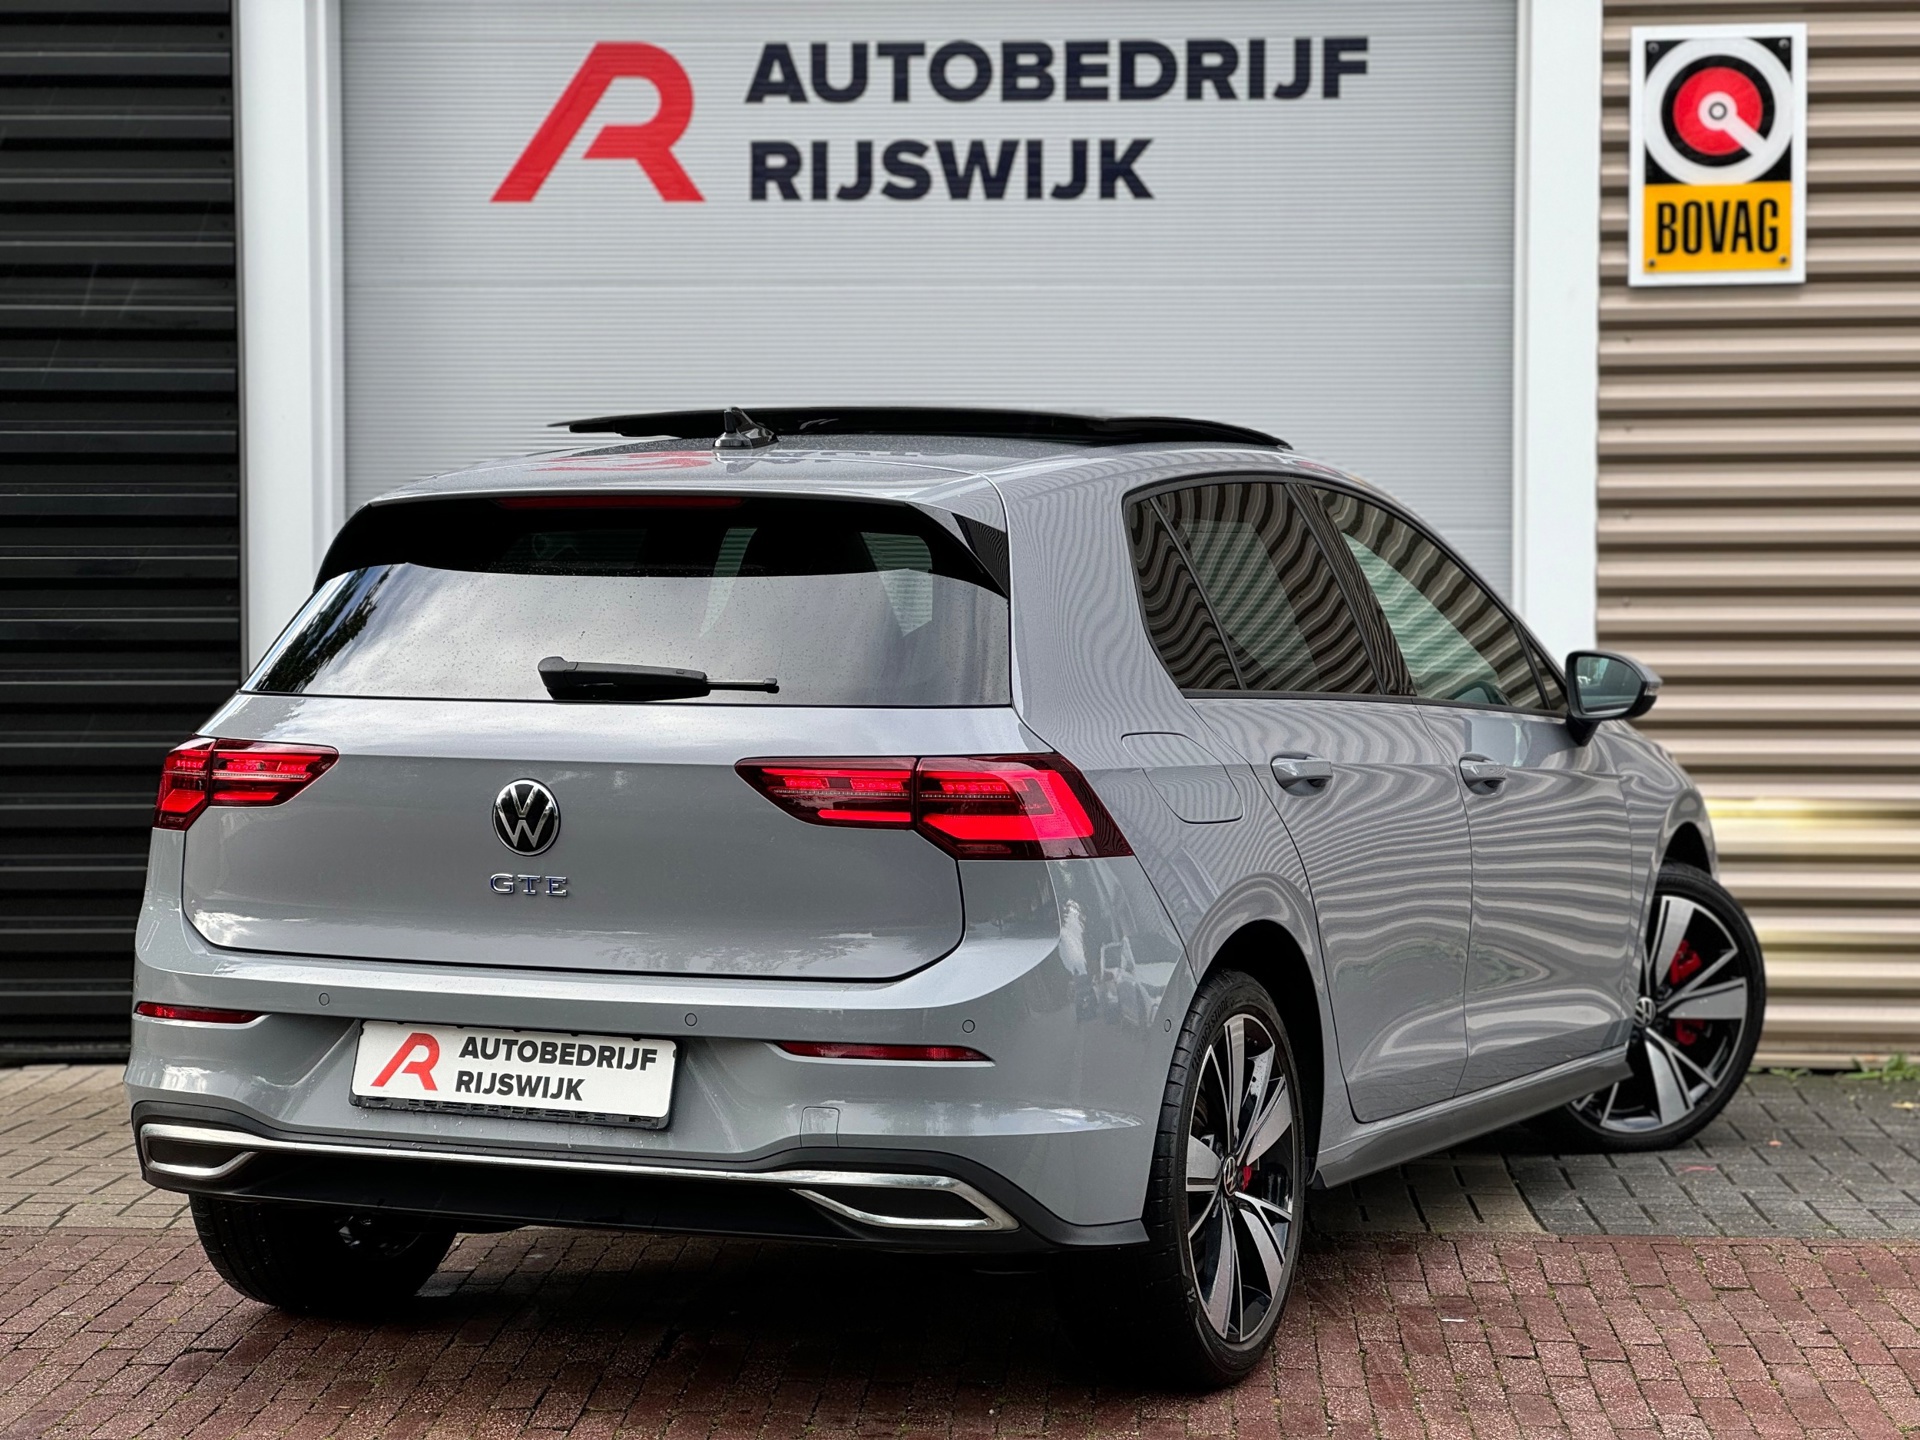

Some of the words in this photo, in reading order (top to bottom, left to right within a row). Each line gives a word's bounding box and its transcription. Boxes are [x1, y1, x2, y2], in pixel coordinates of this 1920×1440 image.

[745, 37, 1369, 103] AUTOBEDRIJF
[749, 138, 1154, 201] RIJSWIJK
[1656, 198, 1779, 256] BOVAG
[490, 872, 568, 896] GTE
[458, 1036, 658, 1071] AUTOBEDRIJF
[455, 1070, 586, 1101] RIJSWIJK
